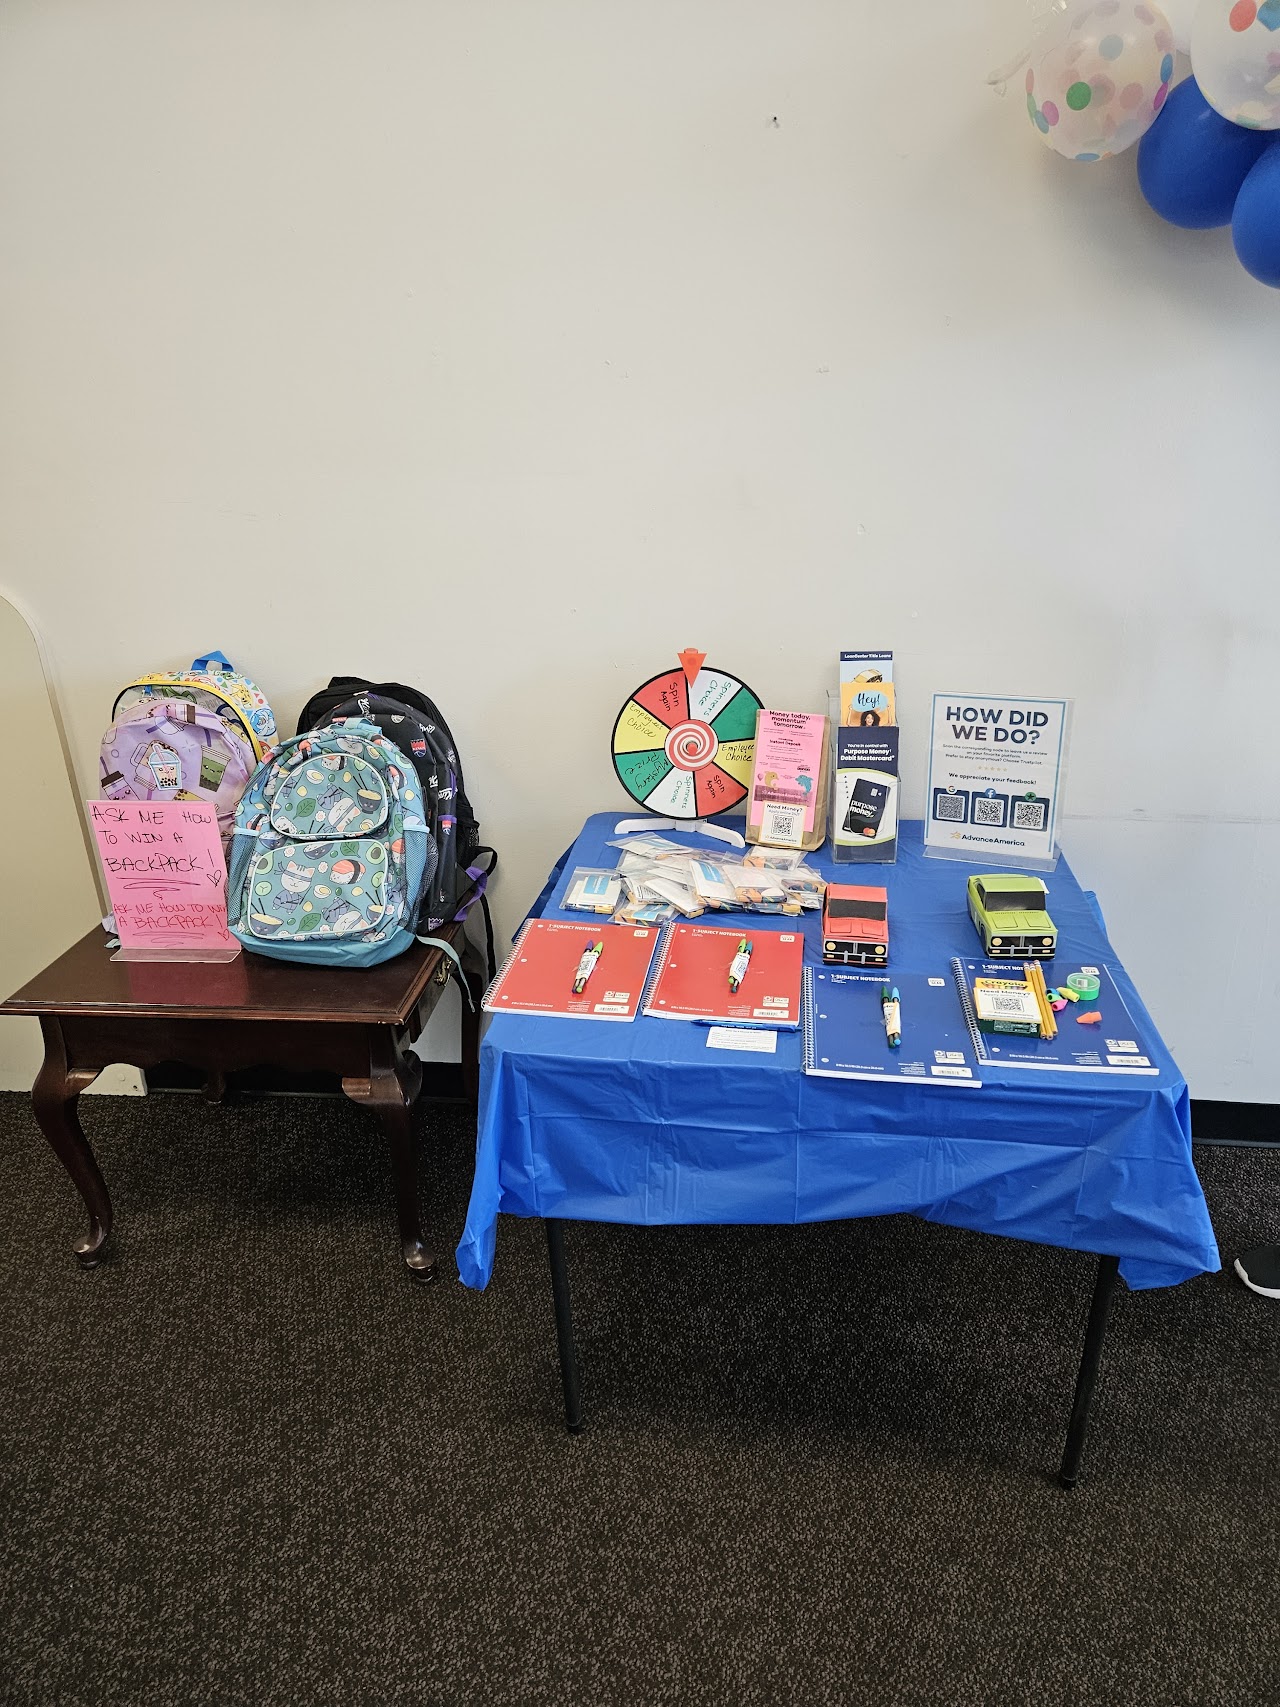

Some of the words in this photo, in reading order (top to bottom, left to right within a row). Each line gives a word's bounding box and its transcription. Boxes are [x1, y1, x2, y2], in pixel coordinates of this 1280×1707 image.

[660, 690, 670, 712] Again
[669, 682, 679, 706] Spin
[698, 679, 718, 706] Choice
[704, 682, 732, 716] Spinners
[858, 693, 880, 708] Hey!
[946, 706, 1003, 724] HOW
[1009, 710, 1049, 727] DID
[627, 718, 656, 738] Choice
[952, 724, 988, 741] WE
[994, 728, 1040, 744] DO?
[725, 753, 753, 762] Choice
[706, 780, 716, 798] Again
[713, 774, 725, 793] Spin
[851, 800, 877, 811] purpose
[92, 806, 129, 824] ASK
[138, 810, 165, 824] ME
[124, 832, 163, 844] WIN
[173, 832, 183, 843] A
[114, 903, 132, 914] ASK
[135, 903, 153, 914] ME
[190, 904, 204, 912] TO
[118, 916, 127, 928] A
